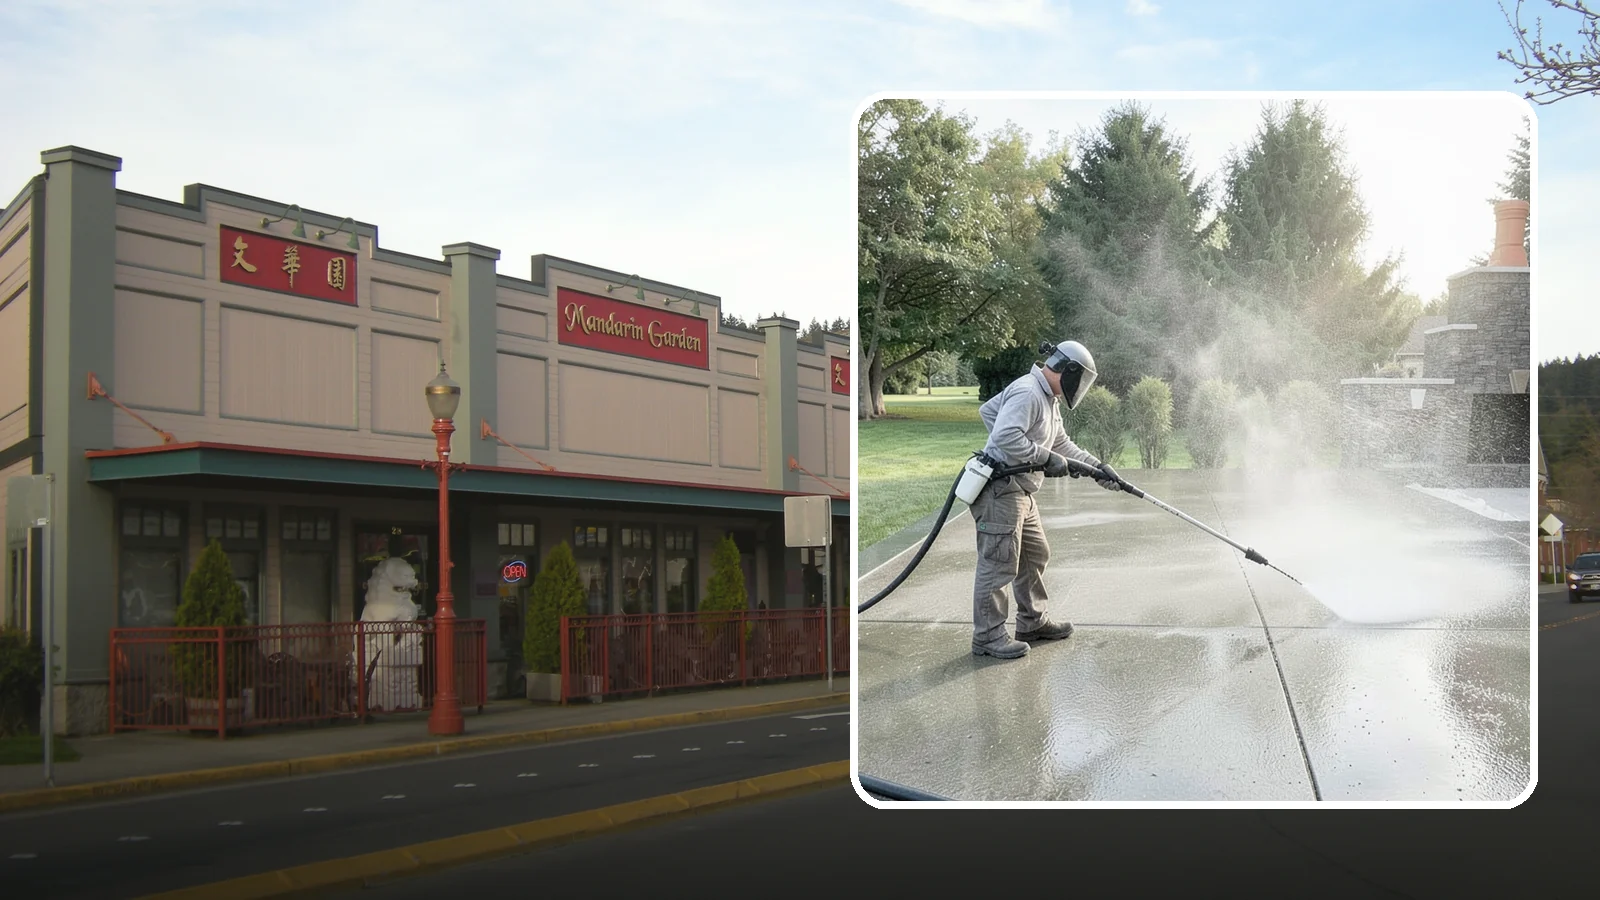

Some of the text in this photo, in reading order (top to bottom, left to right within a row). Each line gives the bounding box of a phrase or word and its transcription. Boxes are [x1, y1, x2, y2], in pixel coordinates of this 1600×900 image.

[231, 235, 346, 291] 文華園
[565, 302, 701, 352] Mandarin Garden
[503, 565, 527, 578] OPEN
